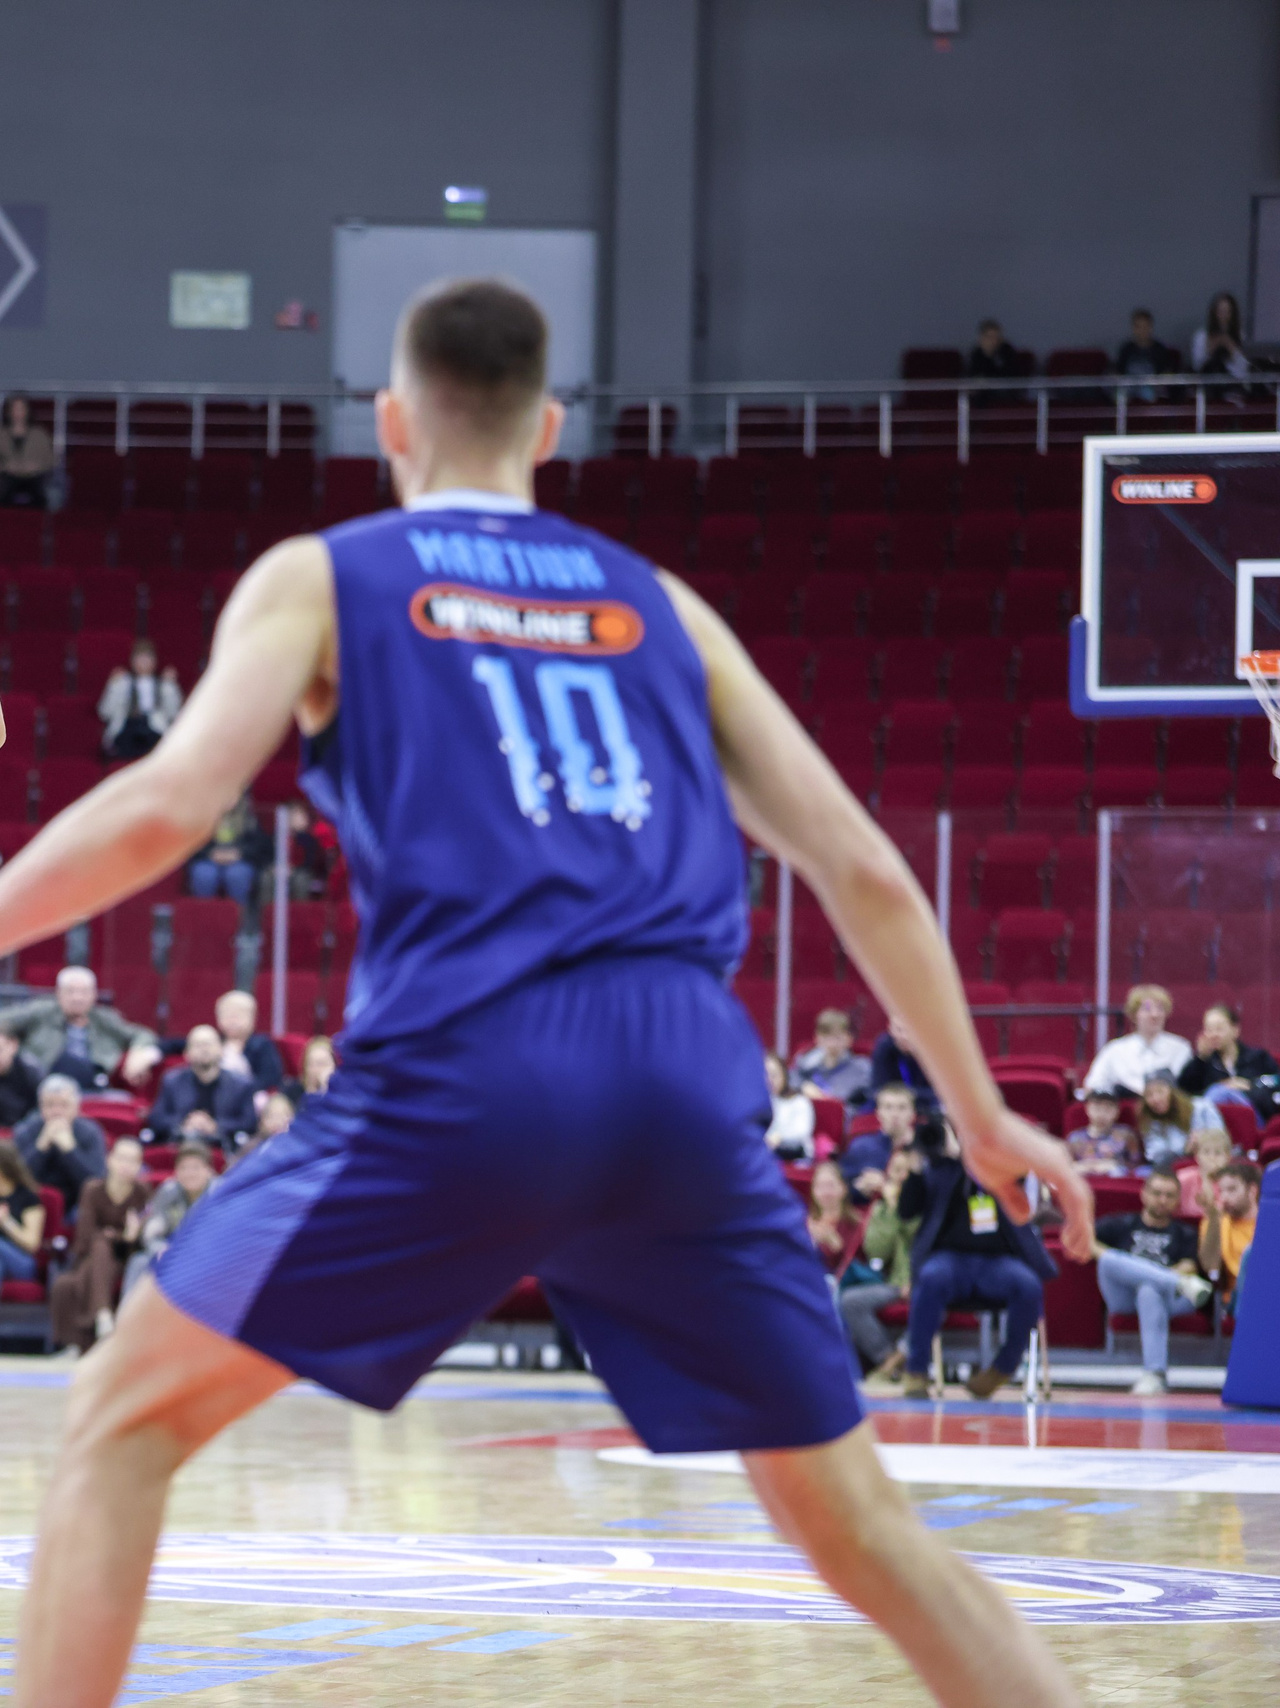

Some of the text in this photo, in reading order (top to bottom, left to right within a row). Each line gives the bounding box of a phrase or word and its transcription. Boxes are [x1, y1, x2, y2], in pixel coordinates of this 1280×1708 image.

[1121, 479, 1194, 499] WINLINE
[428, 592, 592, 646] WINLINE
[471, 654, 652, 832] 10
